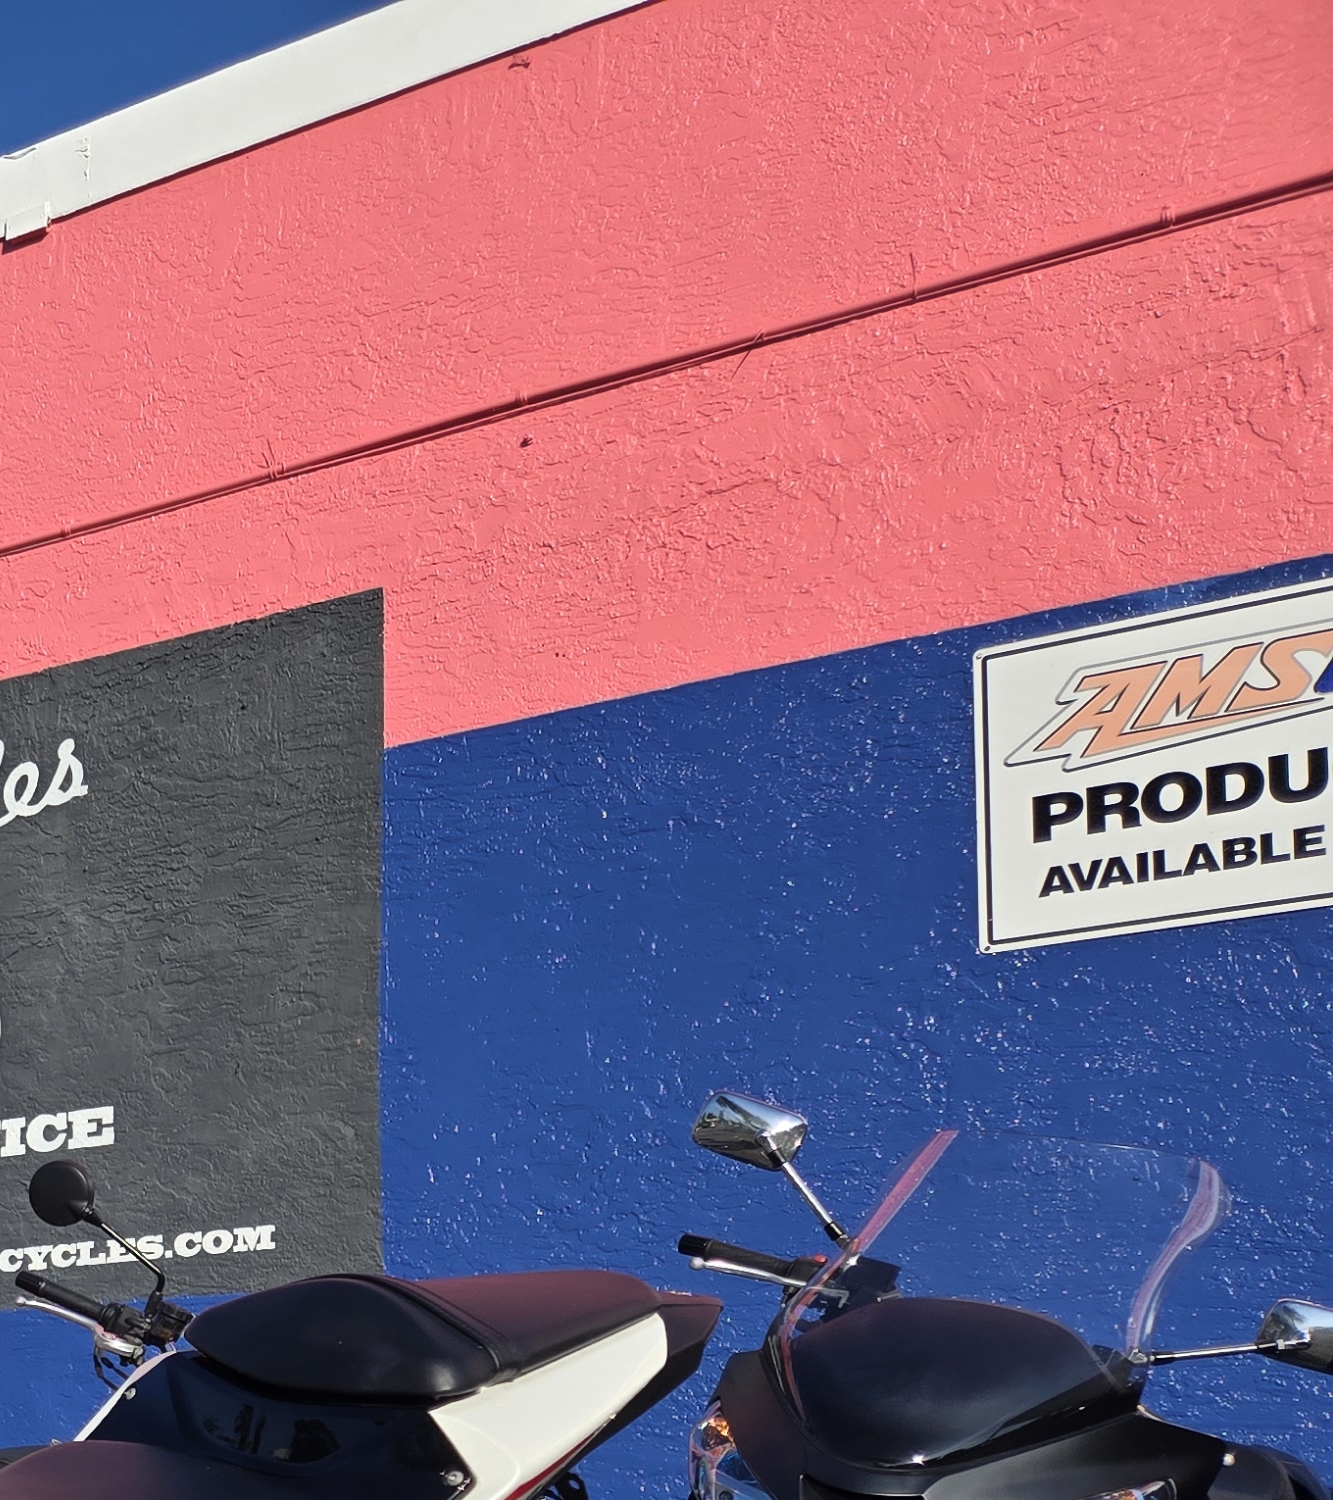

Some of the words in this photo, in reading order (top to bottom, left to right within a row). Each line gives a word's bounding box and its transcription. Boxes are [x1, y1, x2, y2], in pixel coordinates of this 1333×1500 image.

[1033, 628, 1333, 758] AMS
[1032, 747, 1330, 844] PRODU
[1038, 824, 1328, 898] AVAILABLE
